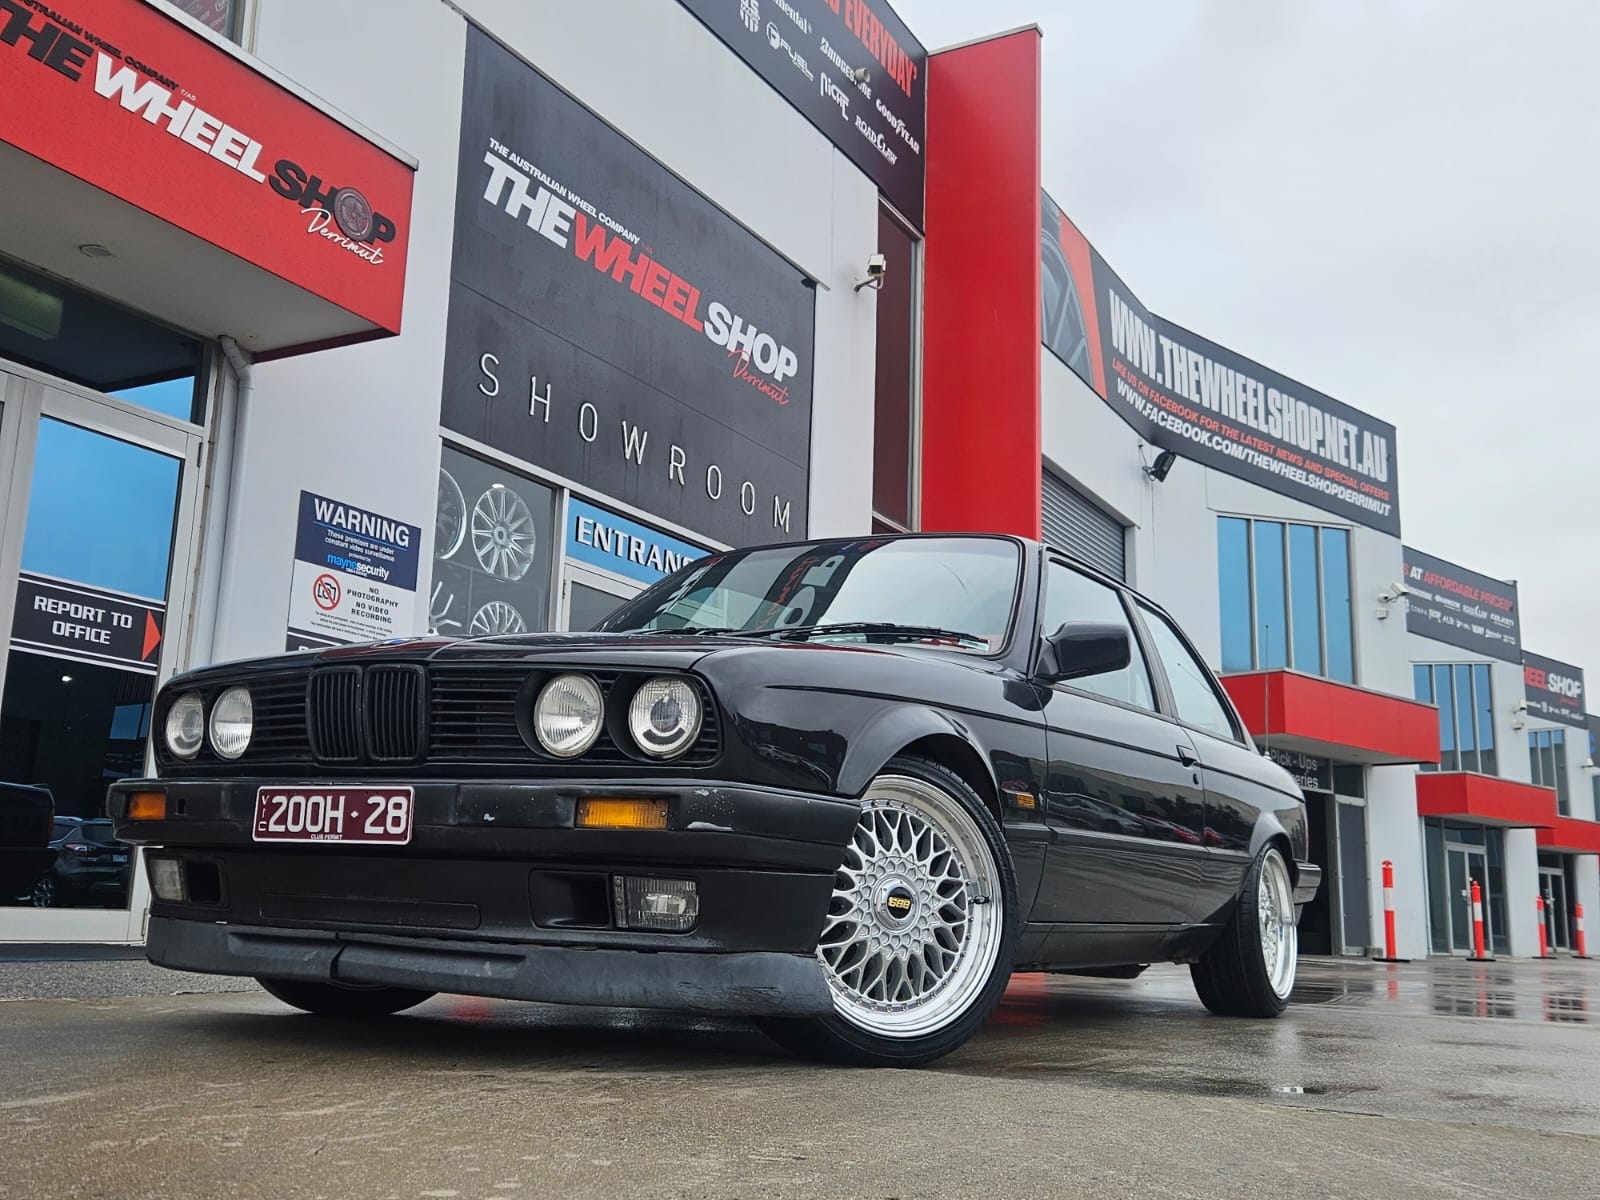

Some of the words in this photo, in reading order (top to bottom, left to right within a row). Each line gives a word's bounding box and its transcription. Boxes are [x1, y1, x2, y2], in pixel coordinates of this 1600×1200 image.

[20, 0, 83, 35] STRALIAN
[85, 31, 122, 59] WHEEL
[124, 56, 179, 90] COMPANY
[0, 0, 94, 82] THE
[94, 52, 265, 184] WHEEL
[268, 159, 397, 244] SHOP
[876, 98, 919, 155] GOODYEAR
[489, 137, 509, 156] THE
[509, 152, 567, 197] AUSTRALIAN
[567, 191, 597, 218] WHEEL
[598, 213, 641, 245] COMPANY
[301, 207, 384, 265] Derrimut
[483, 152, 577, 249] THE
[574, 212, 704, 333] WHEEL
[703, 302, 798, 382] SHOP
[728, 350, 789, 405] Derrimut
[1112, 357, 1127, 377] LIKE
[1127, 372, 1138, 387] US
[1138, 380, 1149, 397] ON
[1149, 388, 1199, 423] FACEBOOK
[1200, 415, 1219, 432] FOR
[1221, 423, 1240, 440] THE
[1240, 432, 1275, 455] LATEST
[1276, 447, 1303, 467] NEWS
[1304, 458, 1323, 474] AND
[1324, 466, 1359, 490] SPECIAL
[1360, 481, 1390, 501] OFFERS
[315, 498, 409, 548] WARNING
[325, 537, 349, 549] constant
[346, 588, 399, 608] PHOTOGRAPHY
[369, 587, 379, 595] NO
[1409, 566, 1423, 580] AT
[1424, 571, 1480, 601] AFFORDABLE
[34, 595, 106, 623] REPORT
[111, 611, 133, 629] TO
[351, 608, 393, 624] RECORDING
[355, 601, 366, 609] NO
[368, 604, 389, 615] VIDEO
[52, 620, 111, 644] OFFICE
[1547, 672, 1582, 699] SHOP
[1298, 754, 1318, 773] Ups
[257, 795, 269, 832] VIC
[268, 795, 346, 833] 200H
[364, 796, 408, 834] 28
